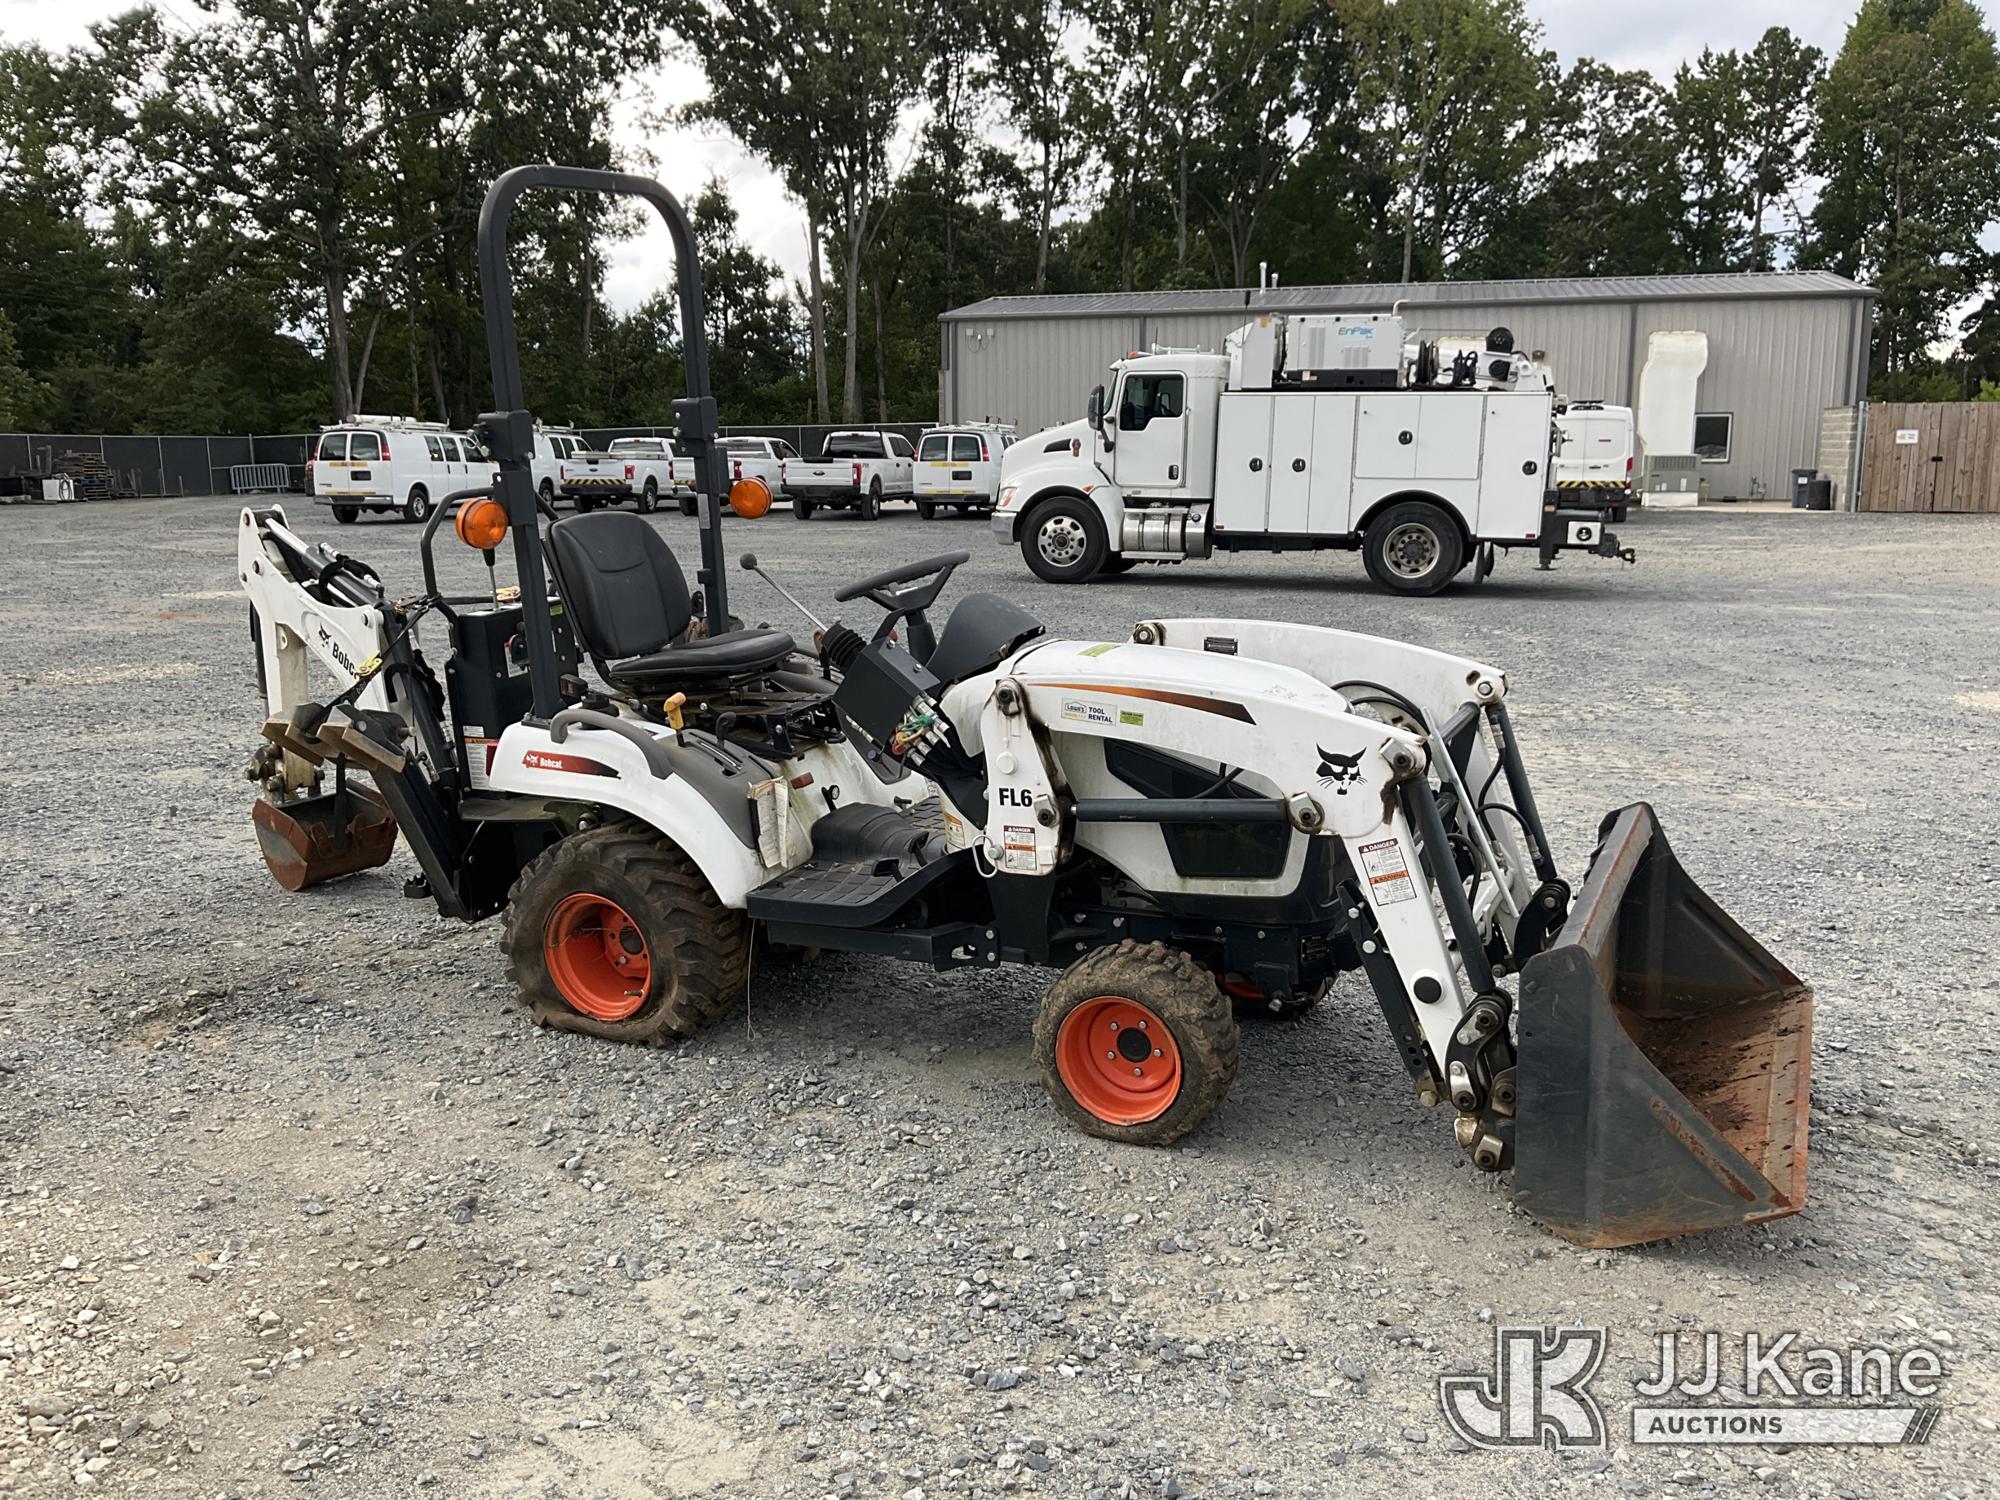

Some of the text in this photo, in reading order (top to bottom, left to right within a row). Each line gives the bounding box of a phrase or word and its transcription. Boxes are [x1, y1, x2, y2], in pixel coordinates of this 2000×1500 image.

[332, 641, 360, 680] Bobc
[1088, 706, 1105, 714] TOOL
[1088, 714, 1113, 723] RENTAL
[540, 757, 563, 769] Bobcat
[998, 787, 1033, 808] FL6
[1369, 841, 1395, 850] DANGER
